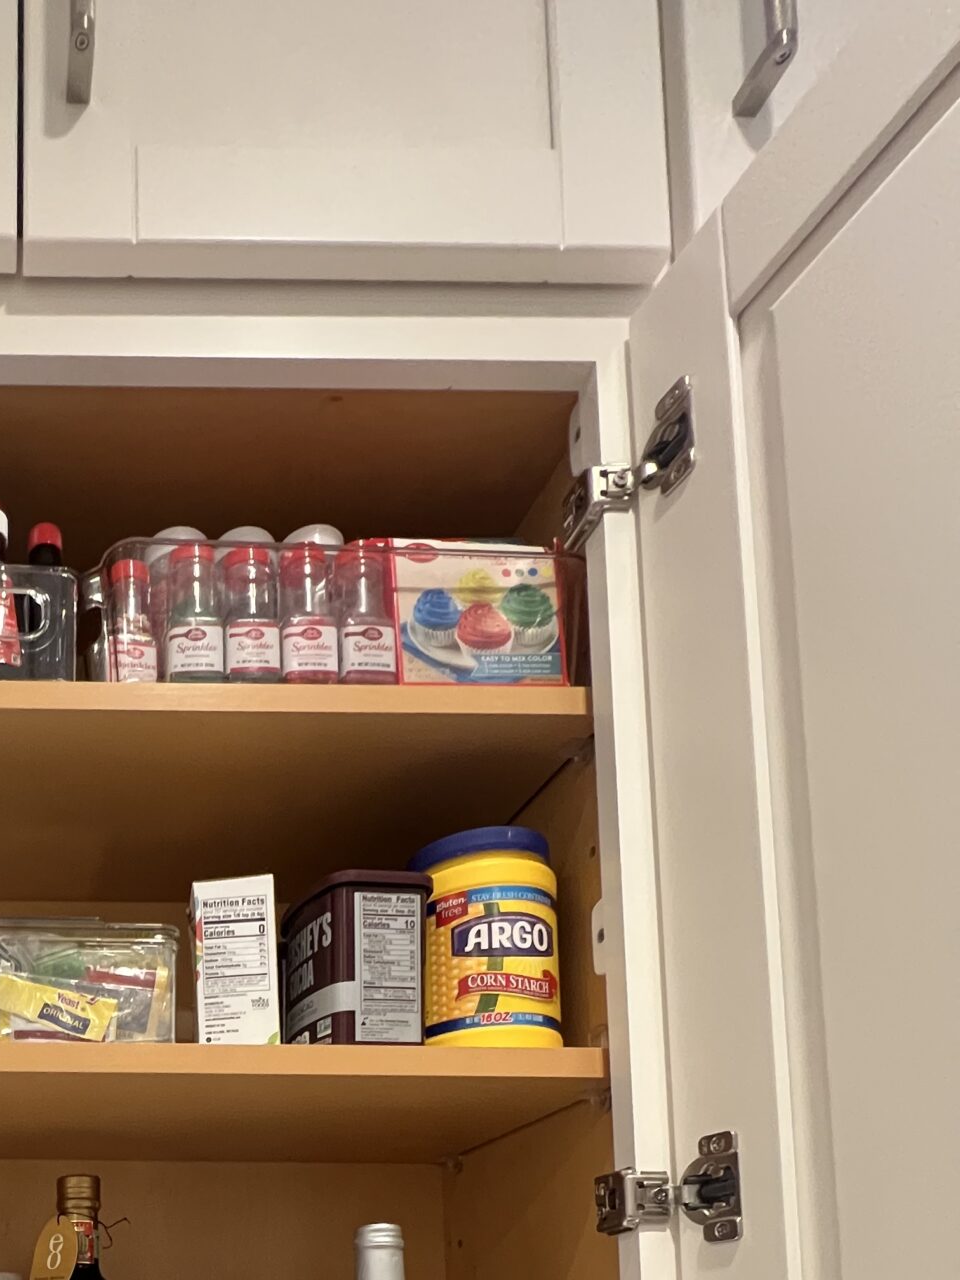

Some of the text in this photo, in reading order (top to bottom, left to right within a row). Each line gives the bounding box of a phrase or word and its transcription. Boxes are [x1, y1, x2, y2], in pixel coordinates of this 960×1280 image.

[176, 642, 217, 655] Sprinkles
[236, 641, 274, 654] Sprinkles
[291, 641, 333, 655] Sprinkles
[353, 641, 393, 654] Sprinkles
[203, 898, 264, 909] Nutrition Facts
[362, 895, 415, 904] Nutrition Facts
[441, 905, 462, 920] free
[204, 924, 265, 938] Calories 0
[363, 920, 415, 929] Calories 10
[464, 921, 548, 953] ARGO
[468, 974, 506, 988] CORN
[509, 975, 549, 993] STARCH
[57, 991, 80, 1009] Yeast
